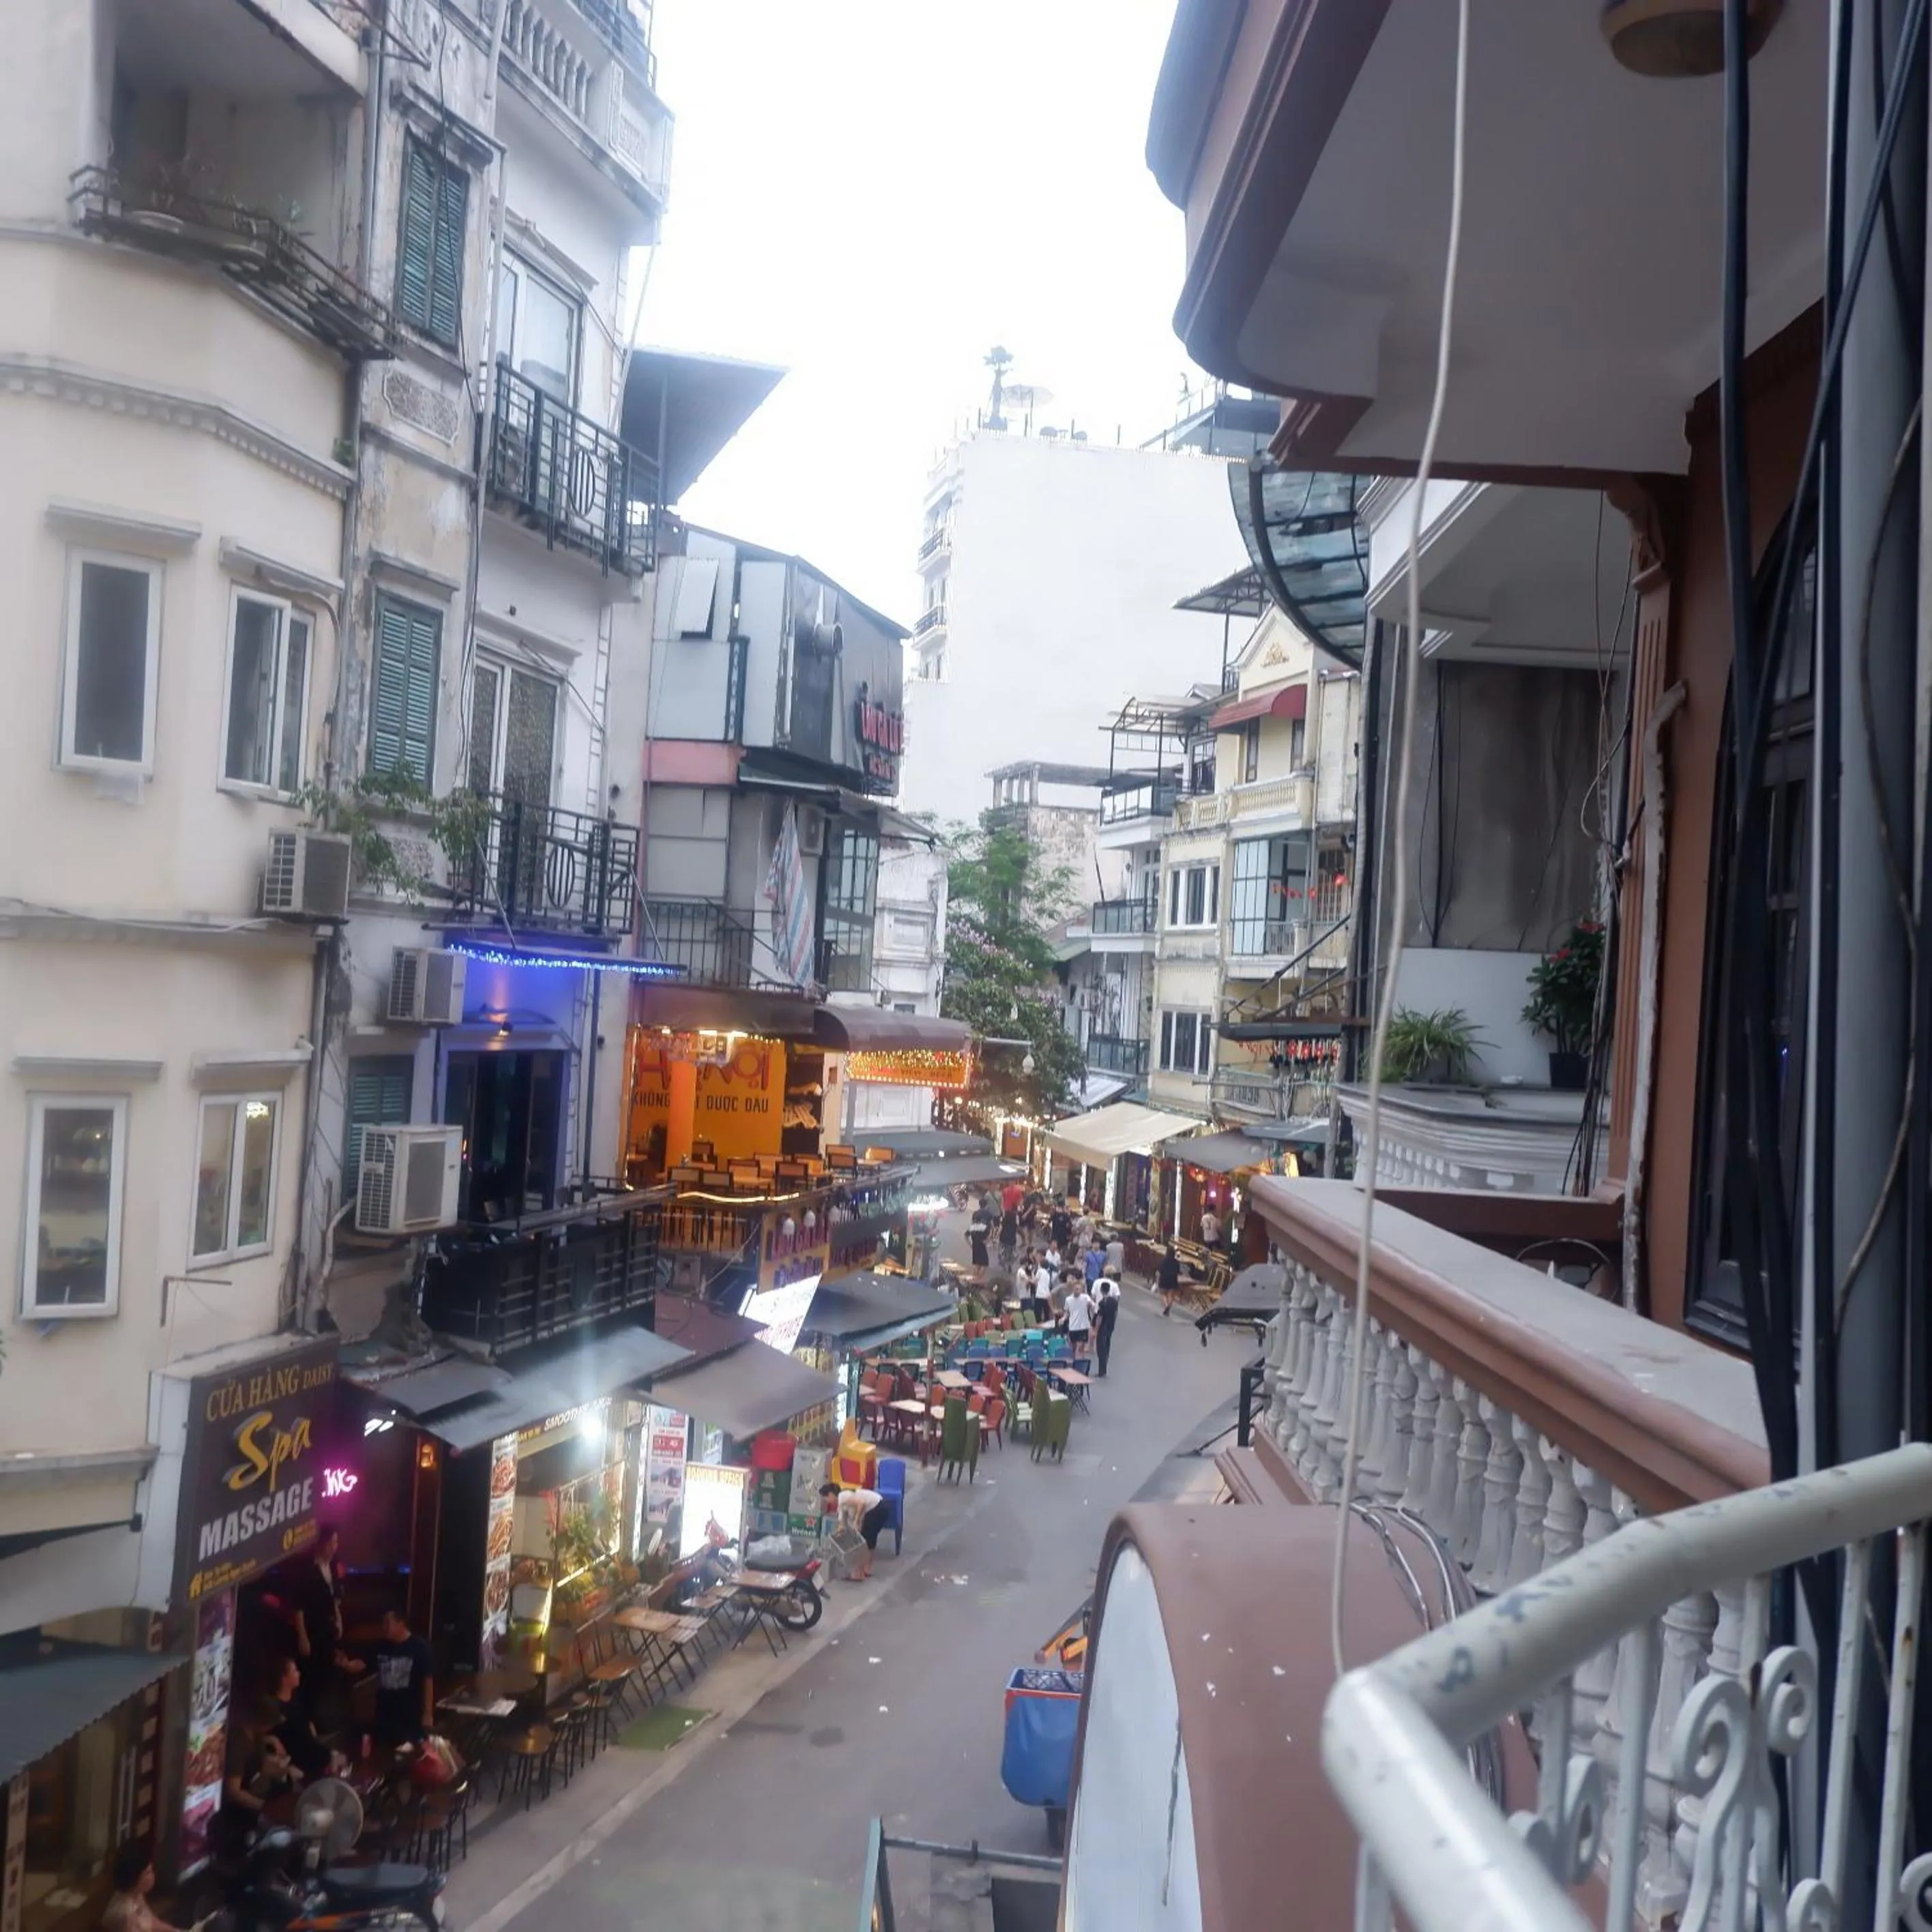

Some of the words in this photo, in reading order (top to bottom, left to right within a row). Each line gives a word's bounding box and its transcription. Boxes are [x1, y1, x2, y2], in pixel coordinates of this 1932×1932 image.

[248, 1365, 300, 1408] HÀNG
[222, 1410, 312, 1493] Spa
[199, 1476, 314, 1561] MASSAGE
